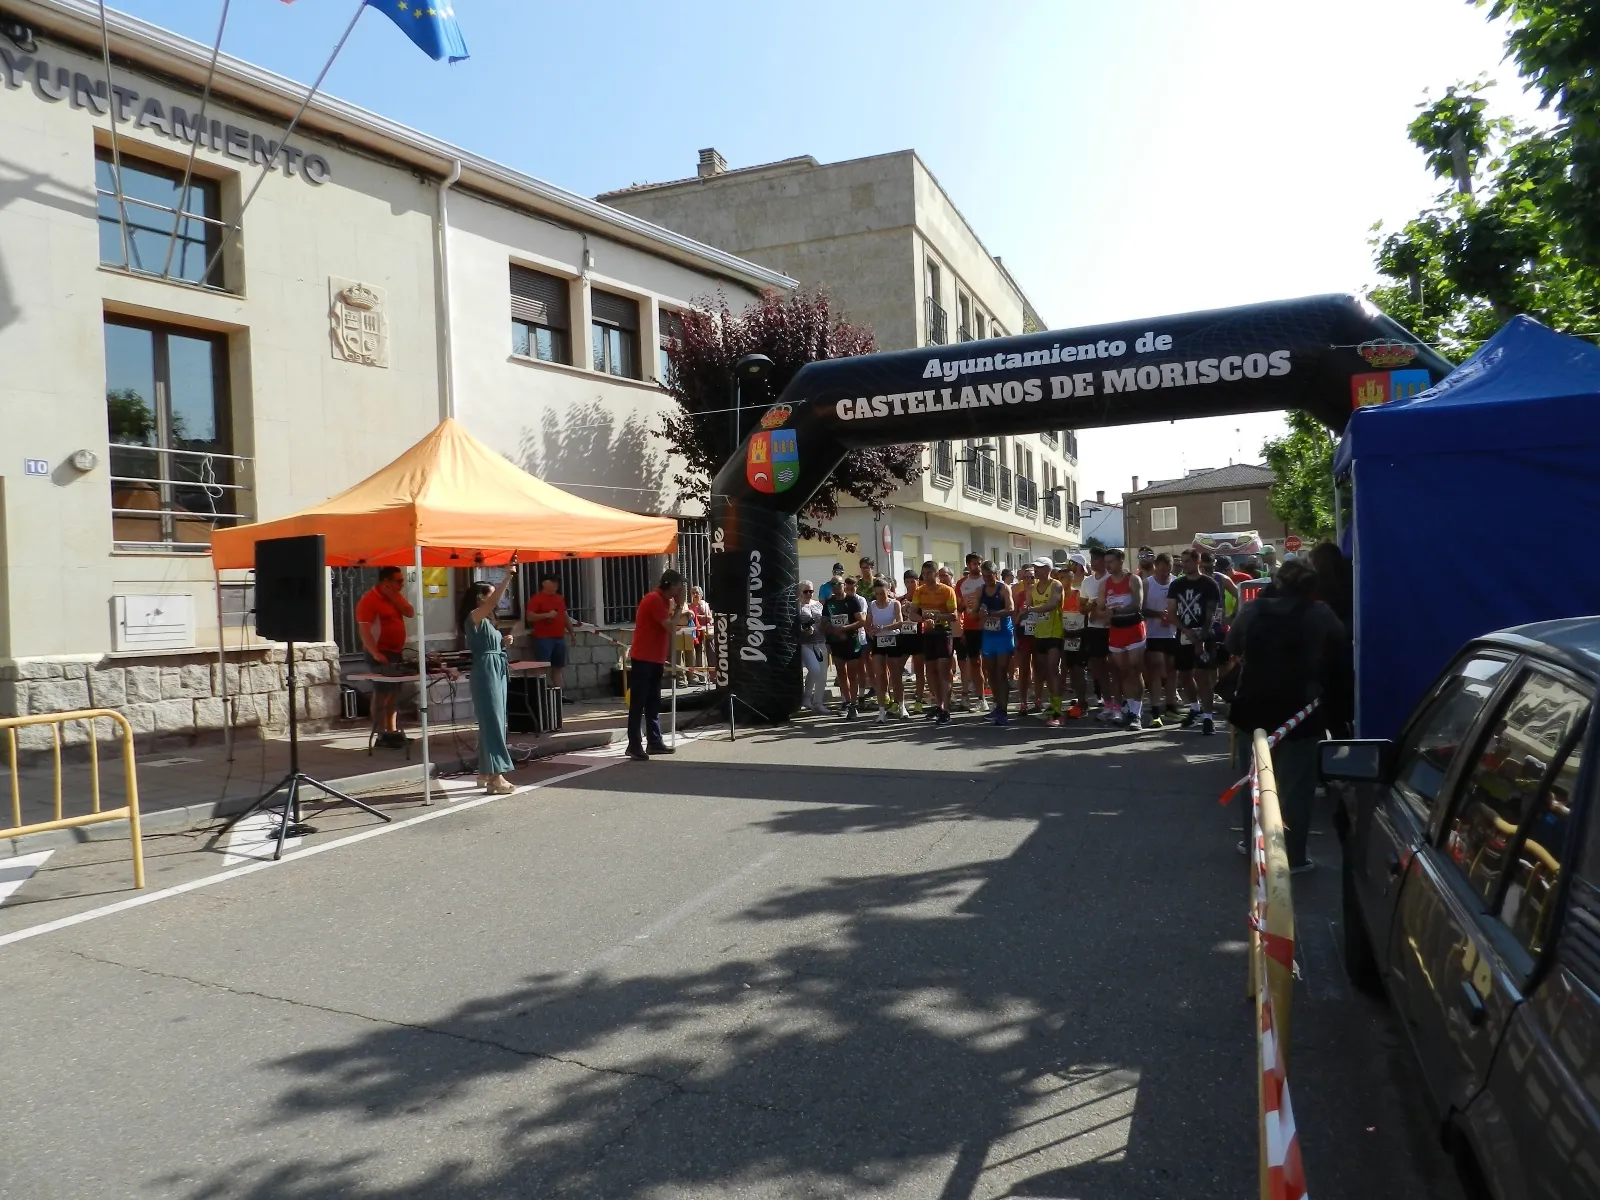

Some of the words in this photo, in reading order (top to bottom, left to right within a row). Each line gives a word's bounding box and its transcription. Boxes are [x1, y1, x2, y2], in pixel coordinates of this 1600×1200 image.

[0, 47, 331, 186] YUNTAMIENTO
[836, 378, 1043, 421] CASTELLANOS
[1051, 373, 1095, 400] DE
[1102, 350, 1292, 395] MORISCOS
[922, 339, 1127, 382] Ayuntamiento
[1135, 332, 1173, 354] de
[28, 461, 47, 474] 10
